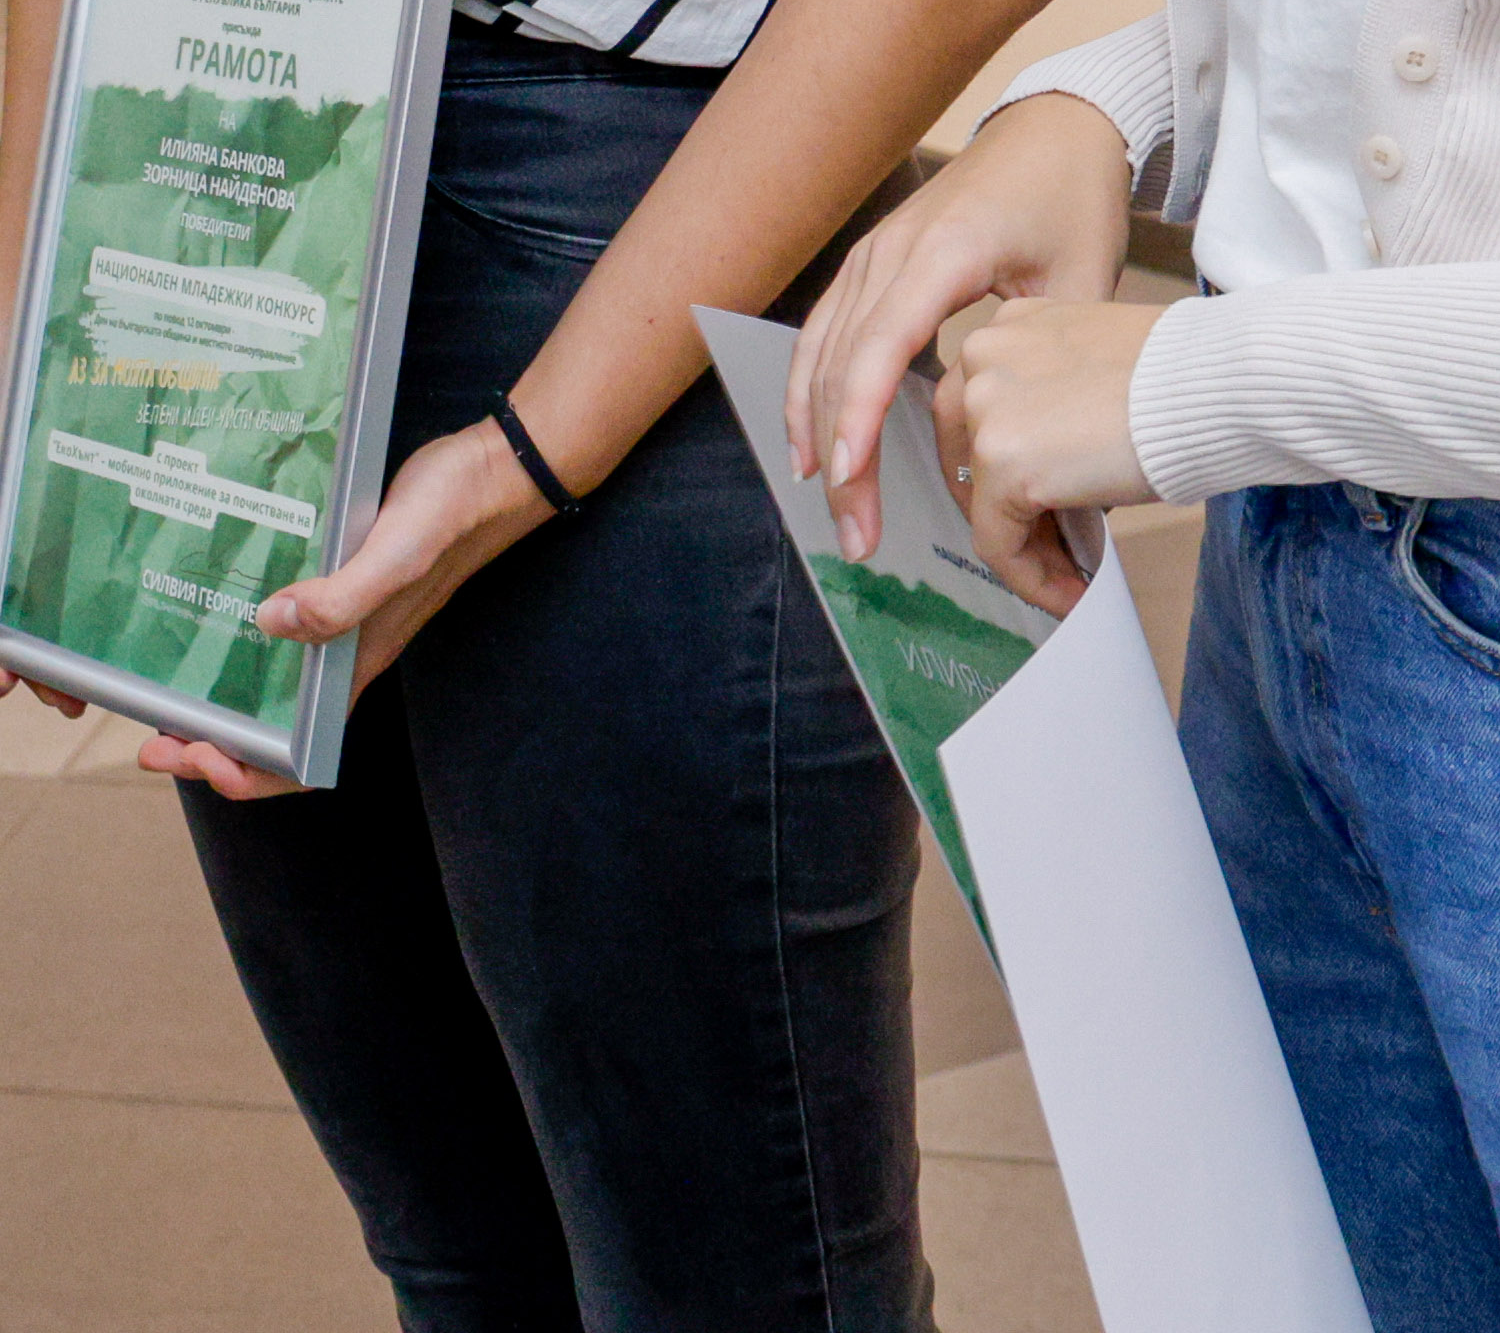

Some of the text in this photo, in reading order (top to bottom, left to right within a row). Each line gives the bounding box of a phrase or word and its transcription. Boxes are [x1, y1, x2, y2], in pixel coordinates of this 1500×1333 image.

[175, 36, 299, 90] ГРАМОТА
[218, 110, 237, 132] НА
[159, 136, 286, 180] ИЛИЯНА БАНКОВА
[142, 162, 296, 212] ЗОРНИЦА НАЙДЕНОВА
[180, 212, 251, 242] ПОБЕДИТЕЛИ
[94, 258, 318, 326] НАЦИОНАЛЕН МЛАДЕЖКИ КОНКУРС
[136, 403, 180, 426] ЗЕЛЕНИ
[255, 410, 305, 434] ОБЩИНИ
[163, 455, 200, 475] проект
[107, 456, 151, 481] мобилно
[152, 470, 218, 501] приложение
[218, 490, 231, 506] за
[232, 494, 296, 526] почистване
[297, 513, 312, 529] на
[134, 485, 213, 521] околната среда
[141, 568, 197, 605] СИЛВИЯ
[198, 588, 259, 624] ГЕОРГИЕ
